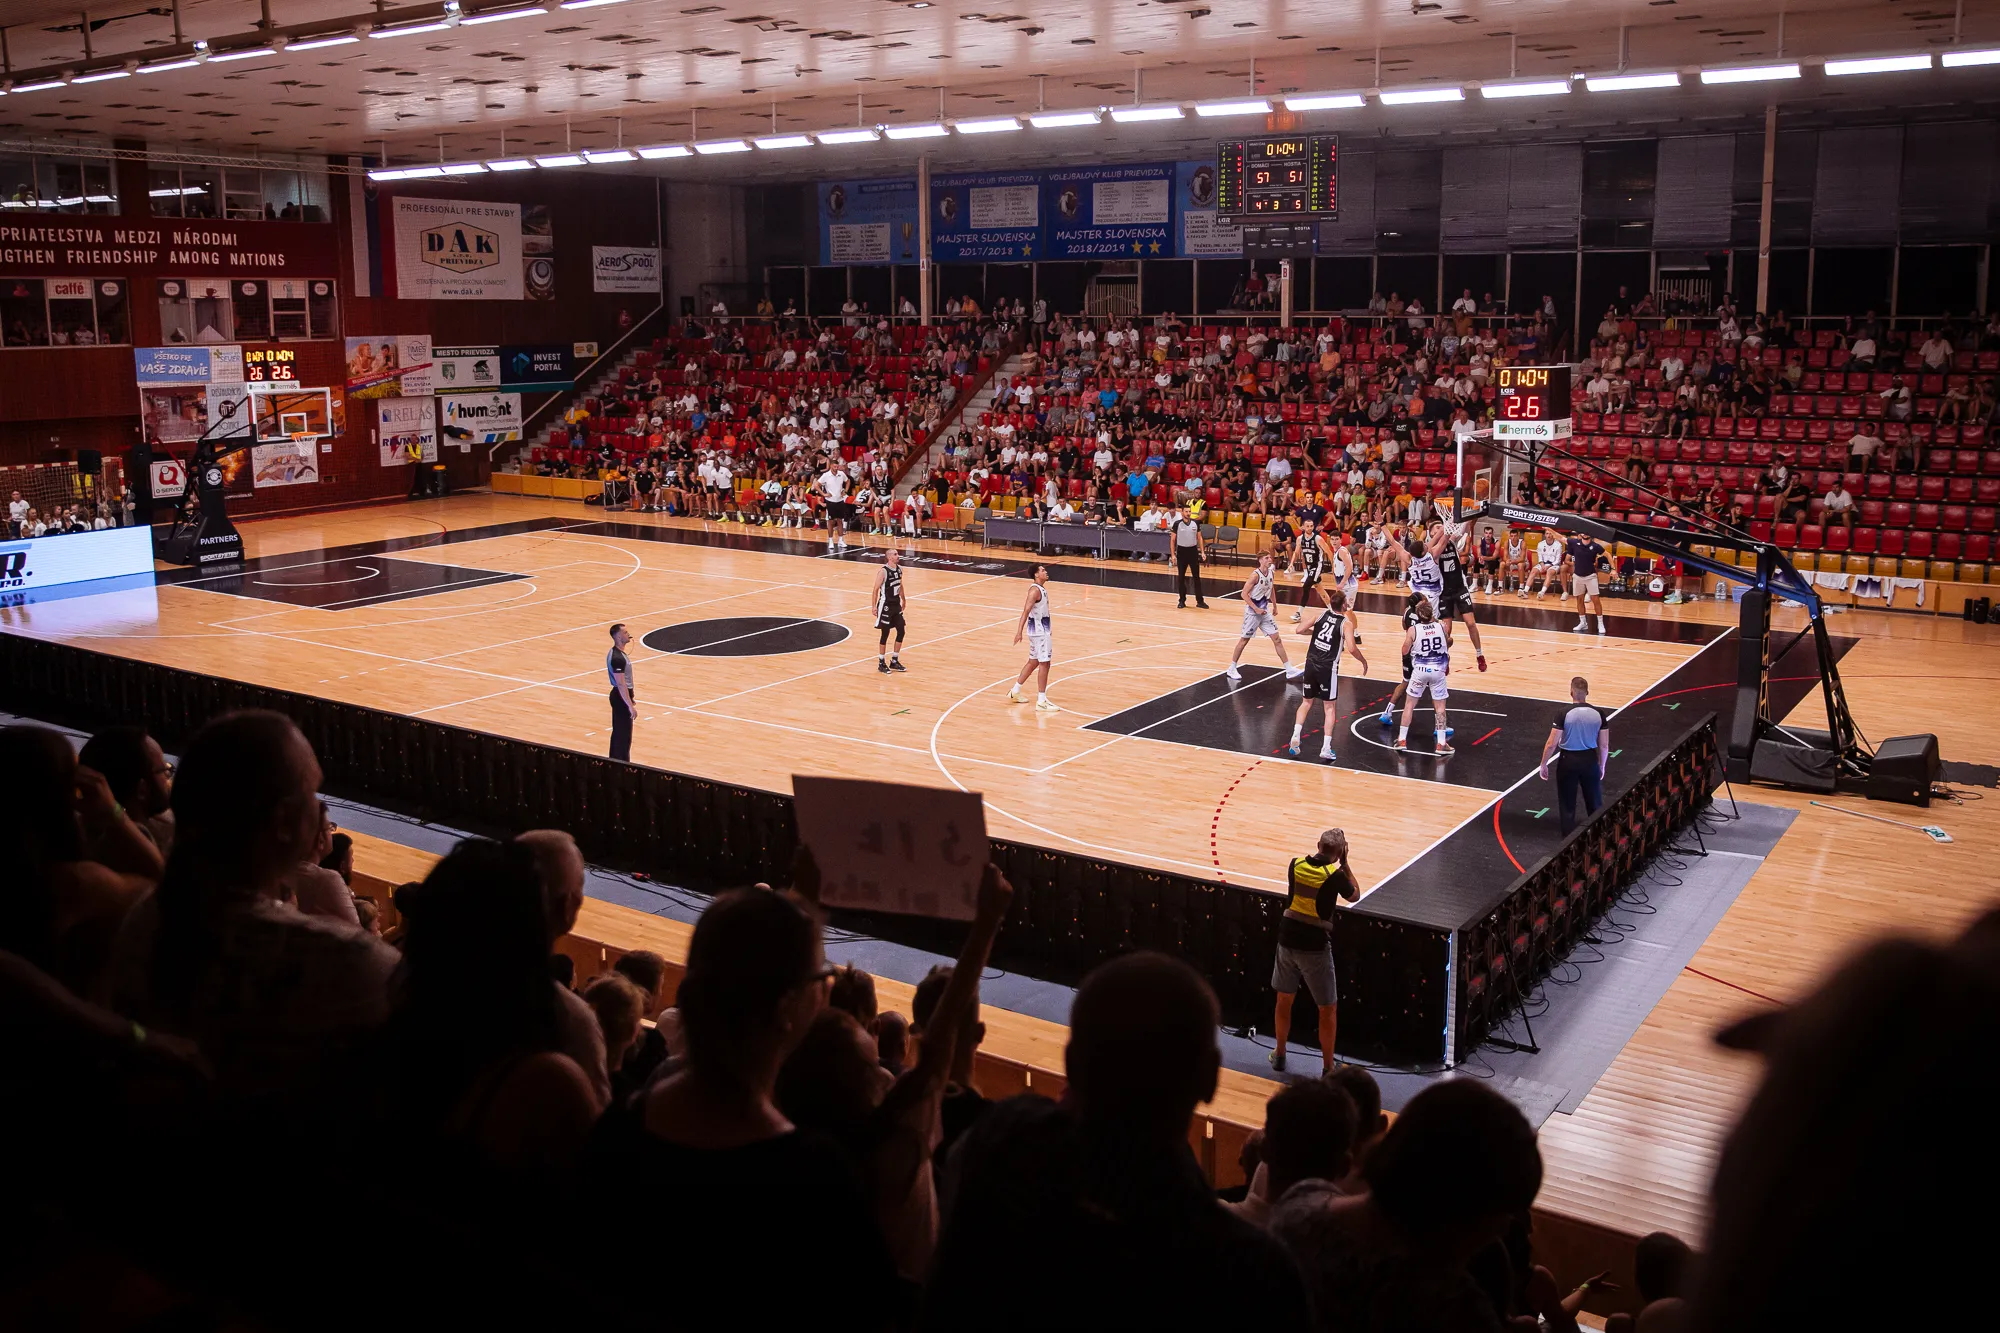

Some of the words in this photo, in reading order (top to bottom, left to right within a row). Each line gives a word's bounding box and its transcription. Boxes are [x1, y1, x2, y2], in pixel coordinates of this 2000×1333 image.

[1048, 170, 1100, 182] VOLEJBALOVÝ
[1102, 170, 1122, 178] KLUB
[1124, 168, 1164, 177] PRIEVIDZA
[1256, 172, 1270, 184] 57
[1289, 170, 1302, 182] 51
[400, 203, 464, 215] PROFESIONÁLI
[484, 208, 515, 217] STAVBY
[1256, 201, 1262, 210] 4
[1273, 200, 1280, 210] 3
[1295, 200, 1301, 209] 5
[1, 226, 103, 244] PRIATEĽSTVA
[114, 230, 161, 244] MEDZI
[174, 227, 238, 246] NÁRODMI
[937, 234, 978, 244] MAJSTER
[981, 232, 1036, 242] SLOVENSKA
[1056, 230, 1102, 240] MAJSTER
[1105, 228, 1166, 239] SLOVENSKA
[959, 246, 1013, 256] 2017/2018
[1067, 244, 1125, 254] 2018/2019
[0, 249, 55, 264] GTHEN
[68, 250, 158, 265] FRIENDSHIP
[170, 252, 220, 265] AMONG
[230, 253, 285, 266] NATIONS
[55, 281, 84, 296] caffé
[154, 351, 179, 361] VŠETKO
[180, 353, 192, 362] PRE
[533, 353, 561, 361] INVEST
[140, 360, 166, 374] VAŠE
[1500, 369, 1548, 387] 01:04
[1508, 396, 1539, 417] 2.6
[394, 406, 433, 421] RELAS
[1508, 424, 1548, 436] hermés
[200, 534, 238, 545] PARTNERS
[1414, 569, 1432, 579] 15
[1317, 621, 1335, 642] 24
[1421, 636, 1442, 652] 88
